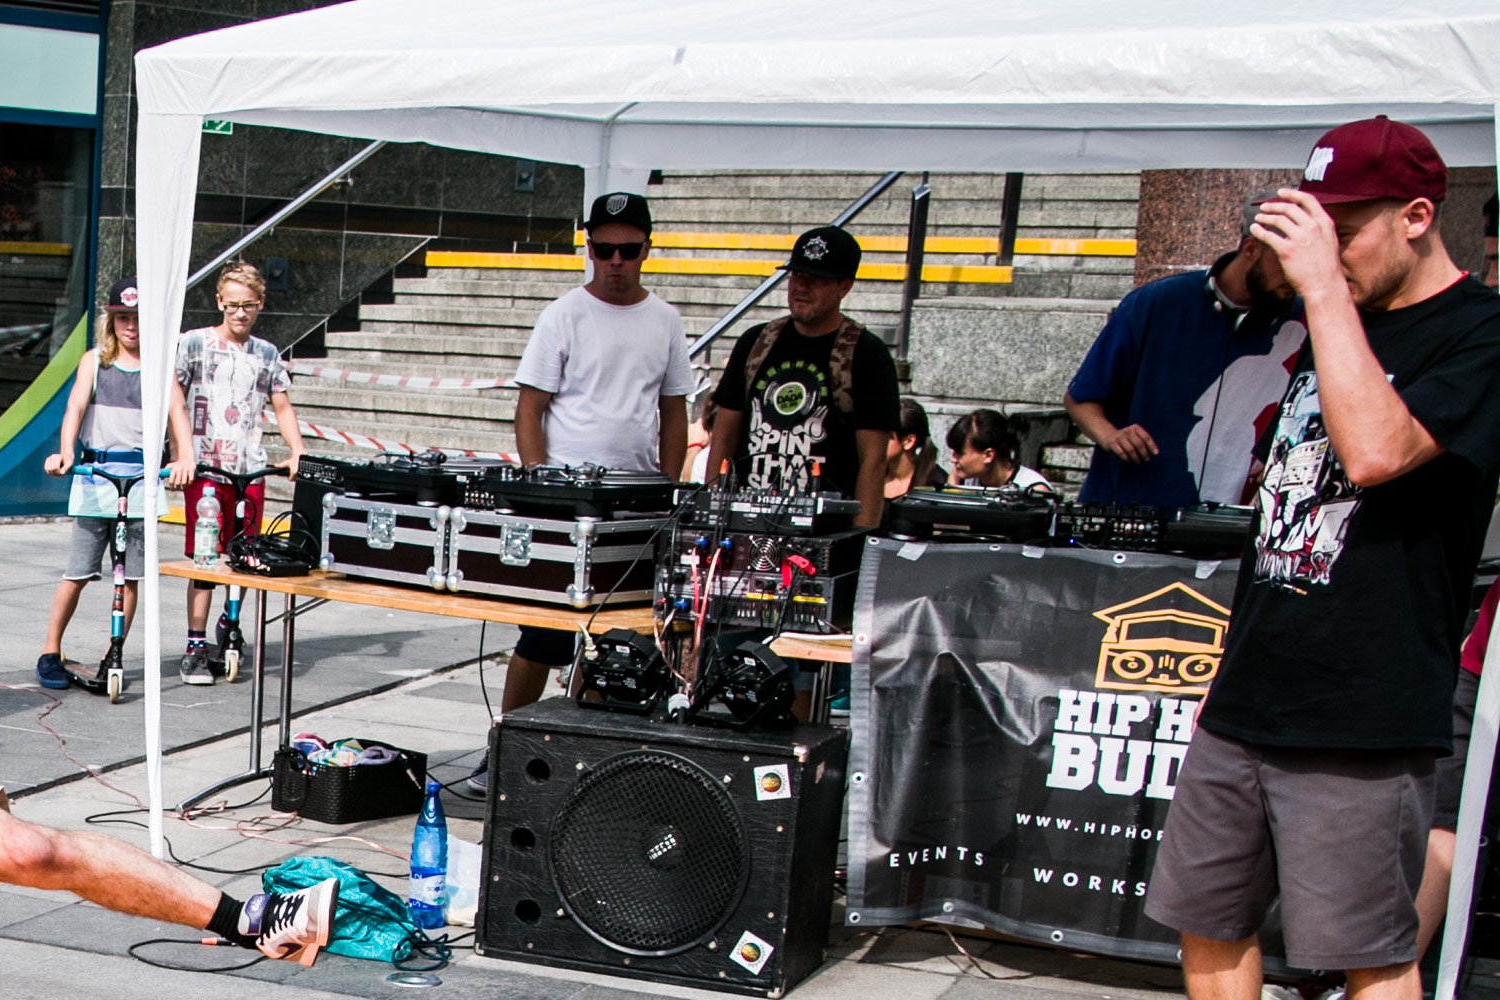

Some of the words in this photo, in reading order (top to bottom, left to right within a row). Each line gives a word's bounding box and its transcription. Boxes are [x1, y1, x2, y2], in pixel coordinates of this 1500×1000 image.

[1054, 689, 1151, 736] HIP
[1155, 697, 1199, 743] H
[1045, 731, 1190, 801] BUD
[889, 846, 984, 867] EVENTS
[1033, 868, 1147, 897] WORKS
